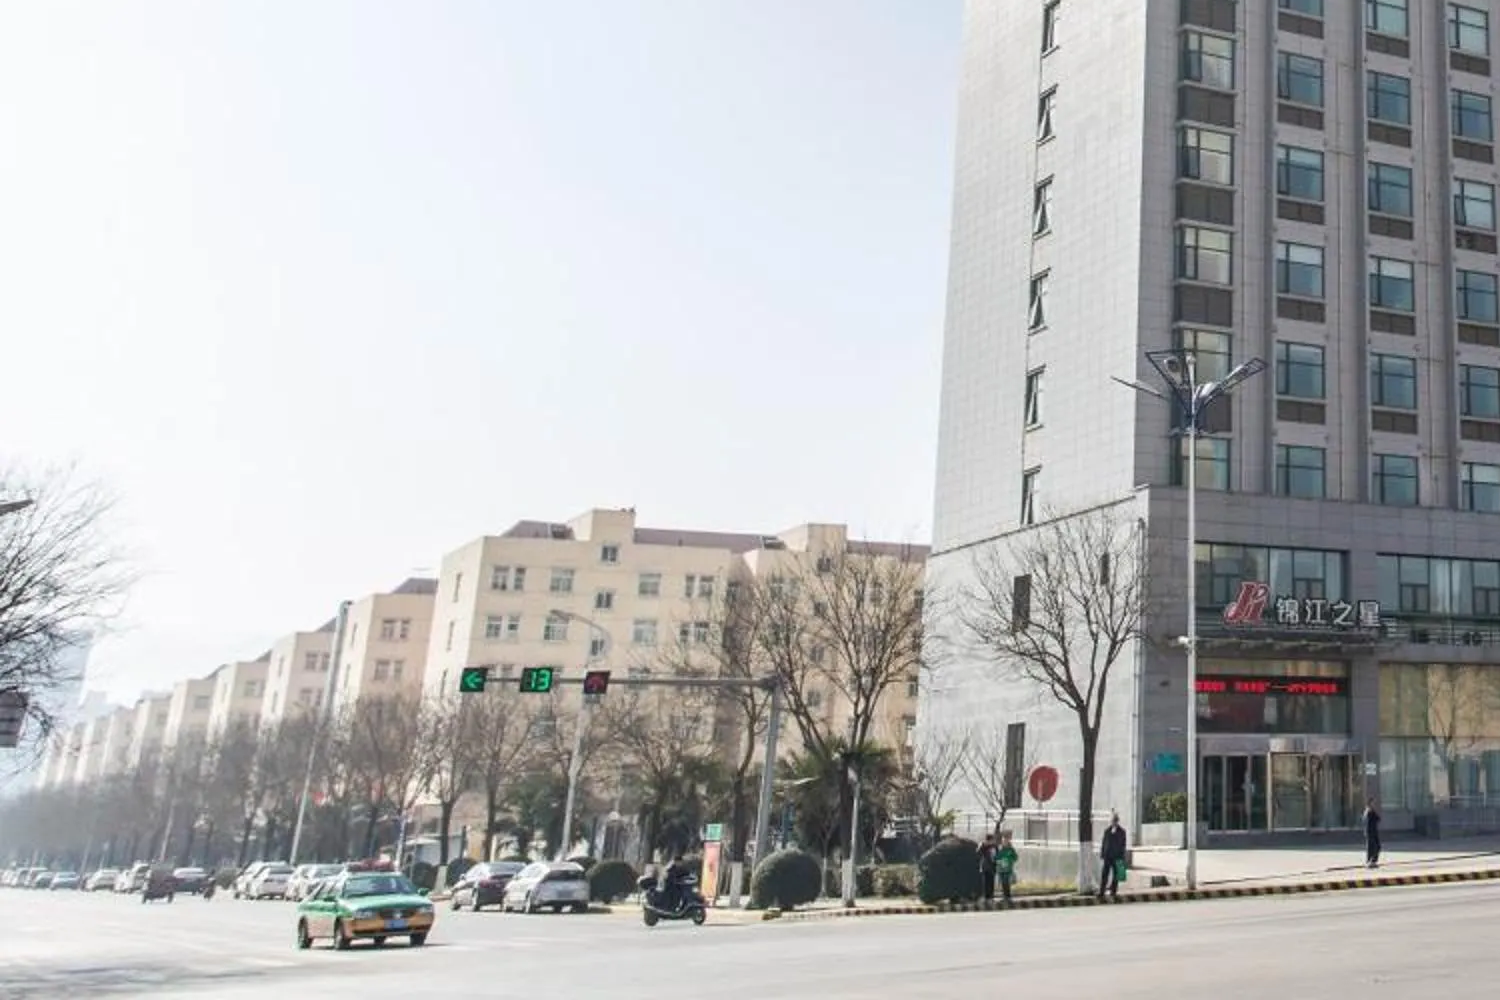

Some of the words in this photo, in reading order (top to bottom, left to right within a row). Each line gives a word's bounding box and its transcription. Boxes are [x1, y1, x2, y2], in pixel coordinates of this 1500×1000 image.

[1276, 597, 1380, 627] 锦江之星
[531, 670, 550, 690] 13
